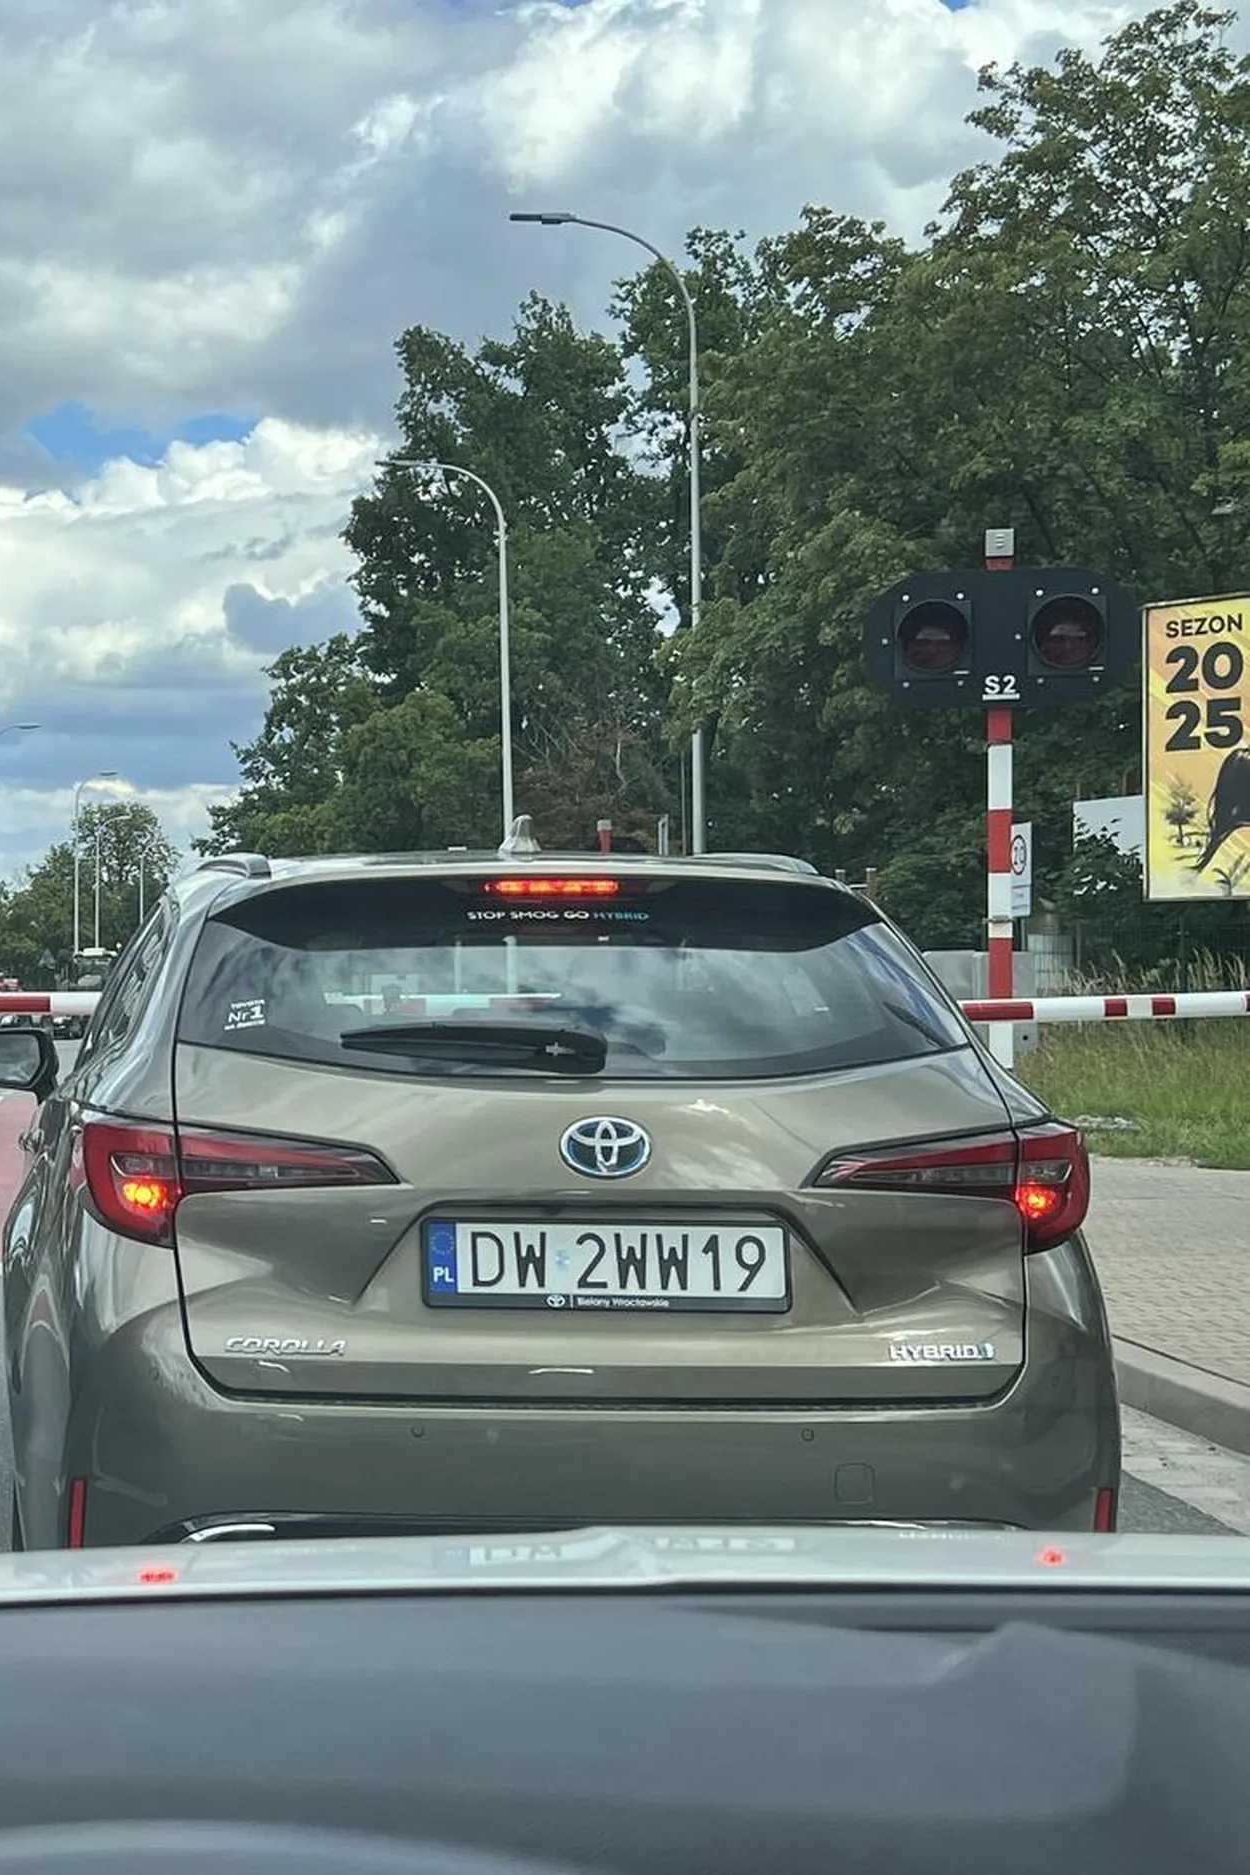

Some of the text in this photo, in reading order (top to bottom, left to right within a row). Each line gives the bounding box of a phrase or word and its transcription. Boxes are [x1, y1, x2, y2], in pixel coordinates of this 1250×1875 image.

[1166, 613, 1243, 638] SEZON
[1166, 641, 1244, 693] 20
[984, 675, 1017, 695] S2
[1165, 697, 1244, 751] 25
[467, 910, 650, 921] STOP SMOG GO HYBRID
[471, 1231, 767, 1292] DW 2WW19
[433, 1267, 455, 1283] PL
[225, 1337, 347, 1356] COROLLA
[889, 1343, 982, 1361] HYBRID
